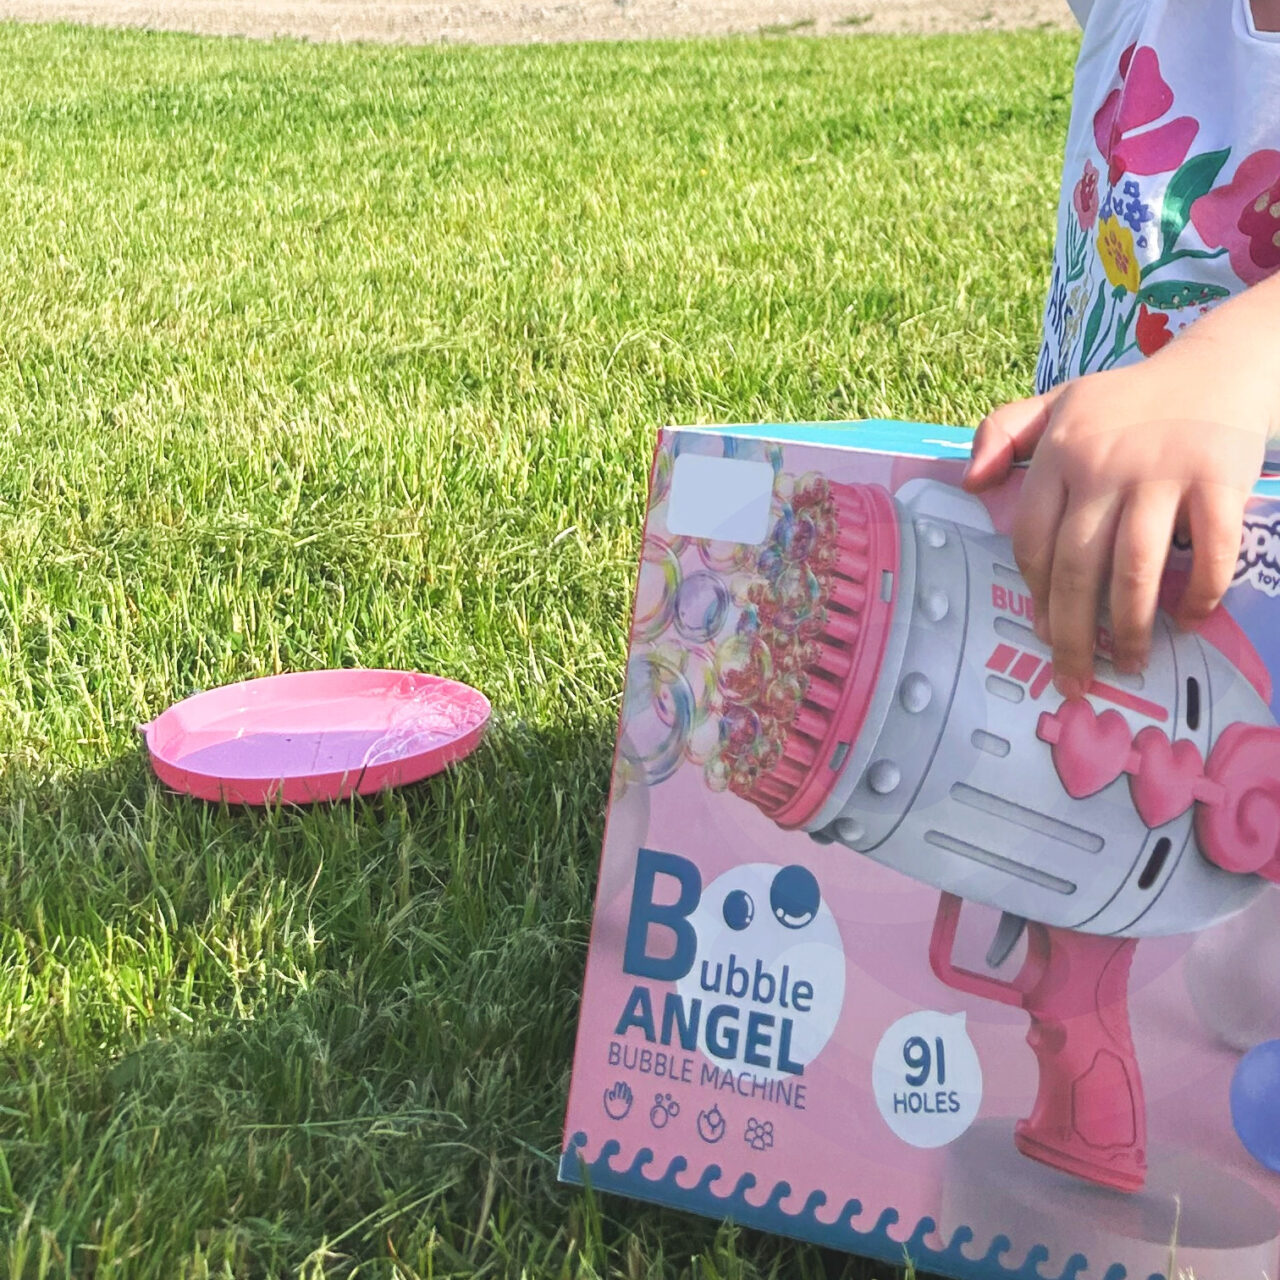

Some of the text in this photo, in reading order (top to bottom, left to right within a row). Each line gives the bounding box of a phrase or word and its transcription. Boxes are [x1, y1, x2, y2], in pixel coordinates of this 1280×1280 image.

[623, 848, 815, 1011] Bubble
[614, 985, 804, 1076] ANGEL
[903, 1035, 945, 1087] 91
[607, 1040, 808, 1110] BUBBLE MACHINE
[893, 1090, 961, 1114] HOLES
